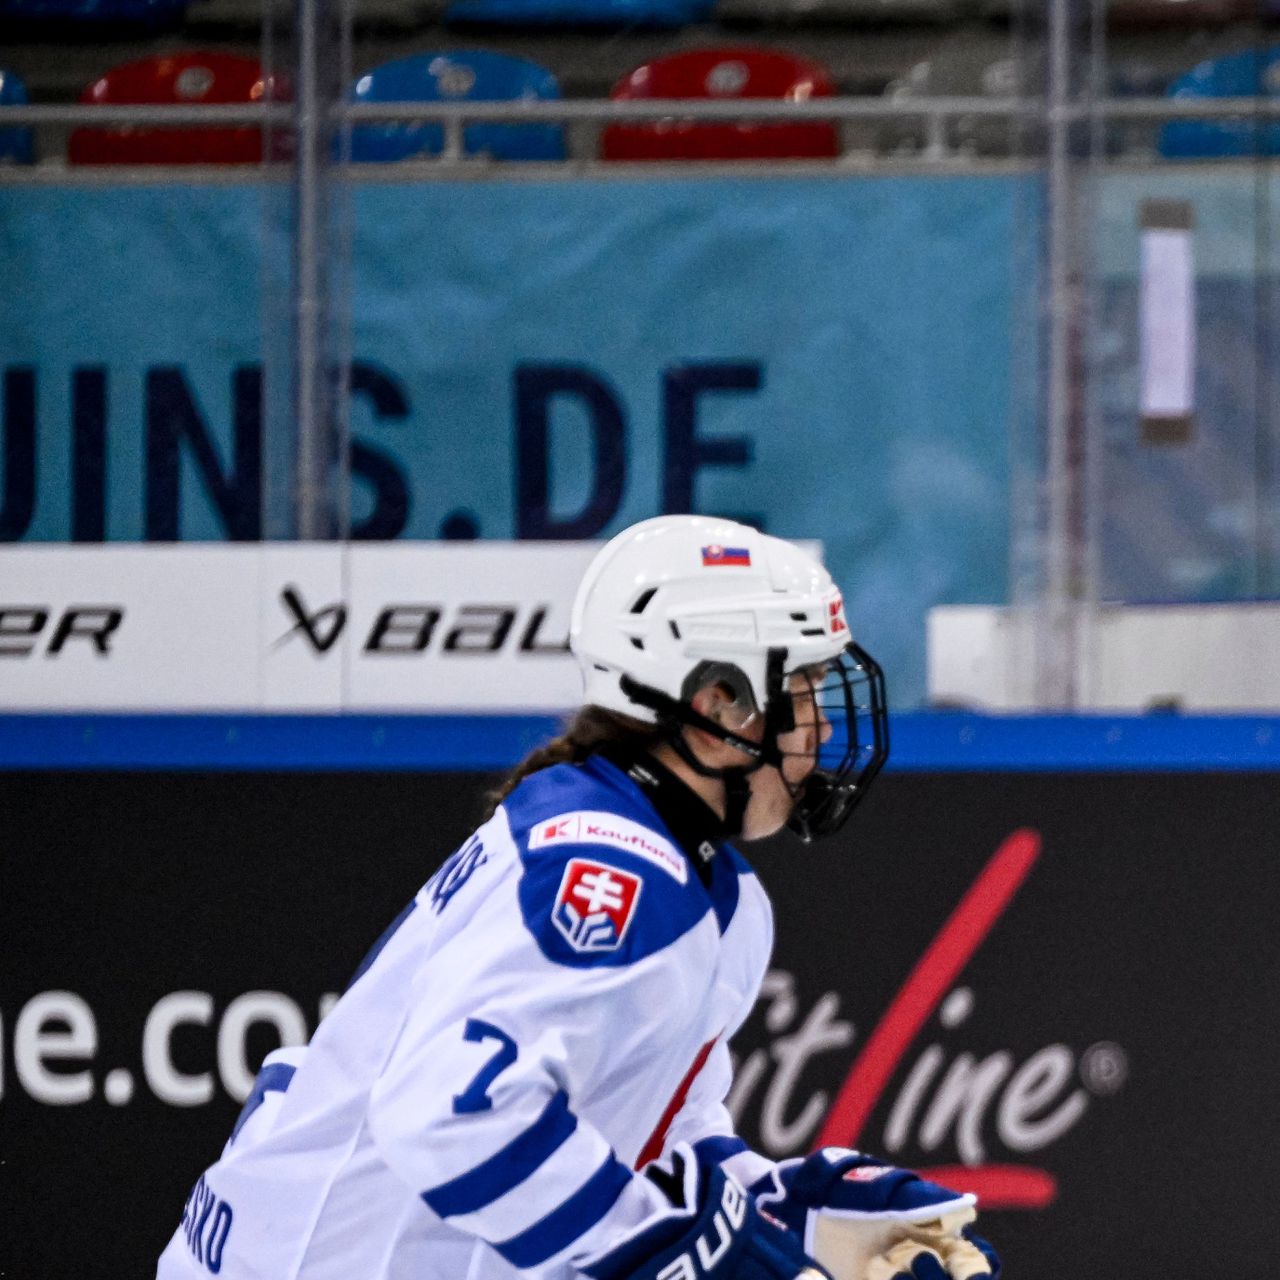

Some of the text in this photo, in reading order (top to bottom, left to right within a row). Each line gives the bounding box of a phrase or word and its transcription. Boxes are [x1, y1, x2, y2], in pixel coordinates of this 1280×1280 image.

[586, 823, 683, 873] Kaufland
[14, 990, 345, 1106] e.co
[453, 1017, 518, 1115] 7
